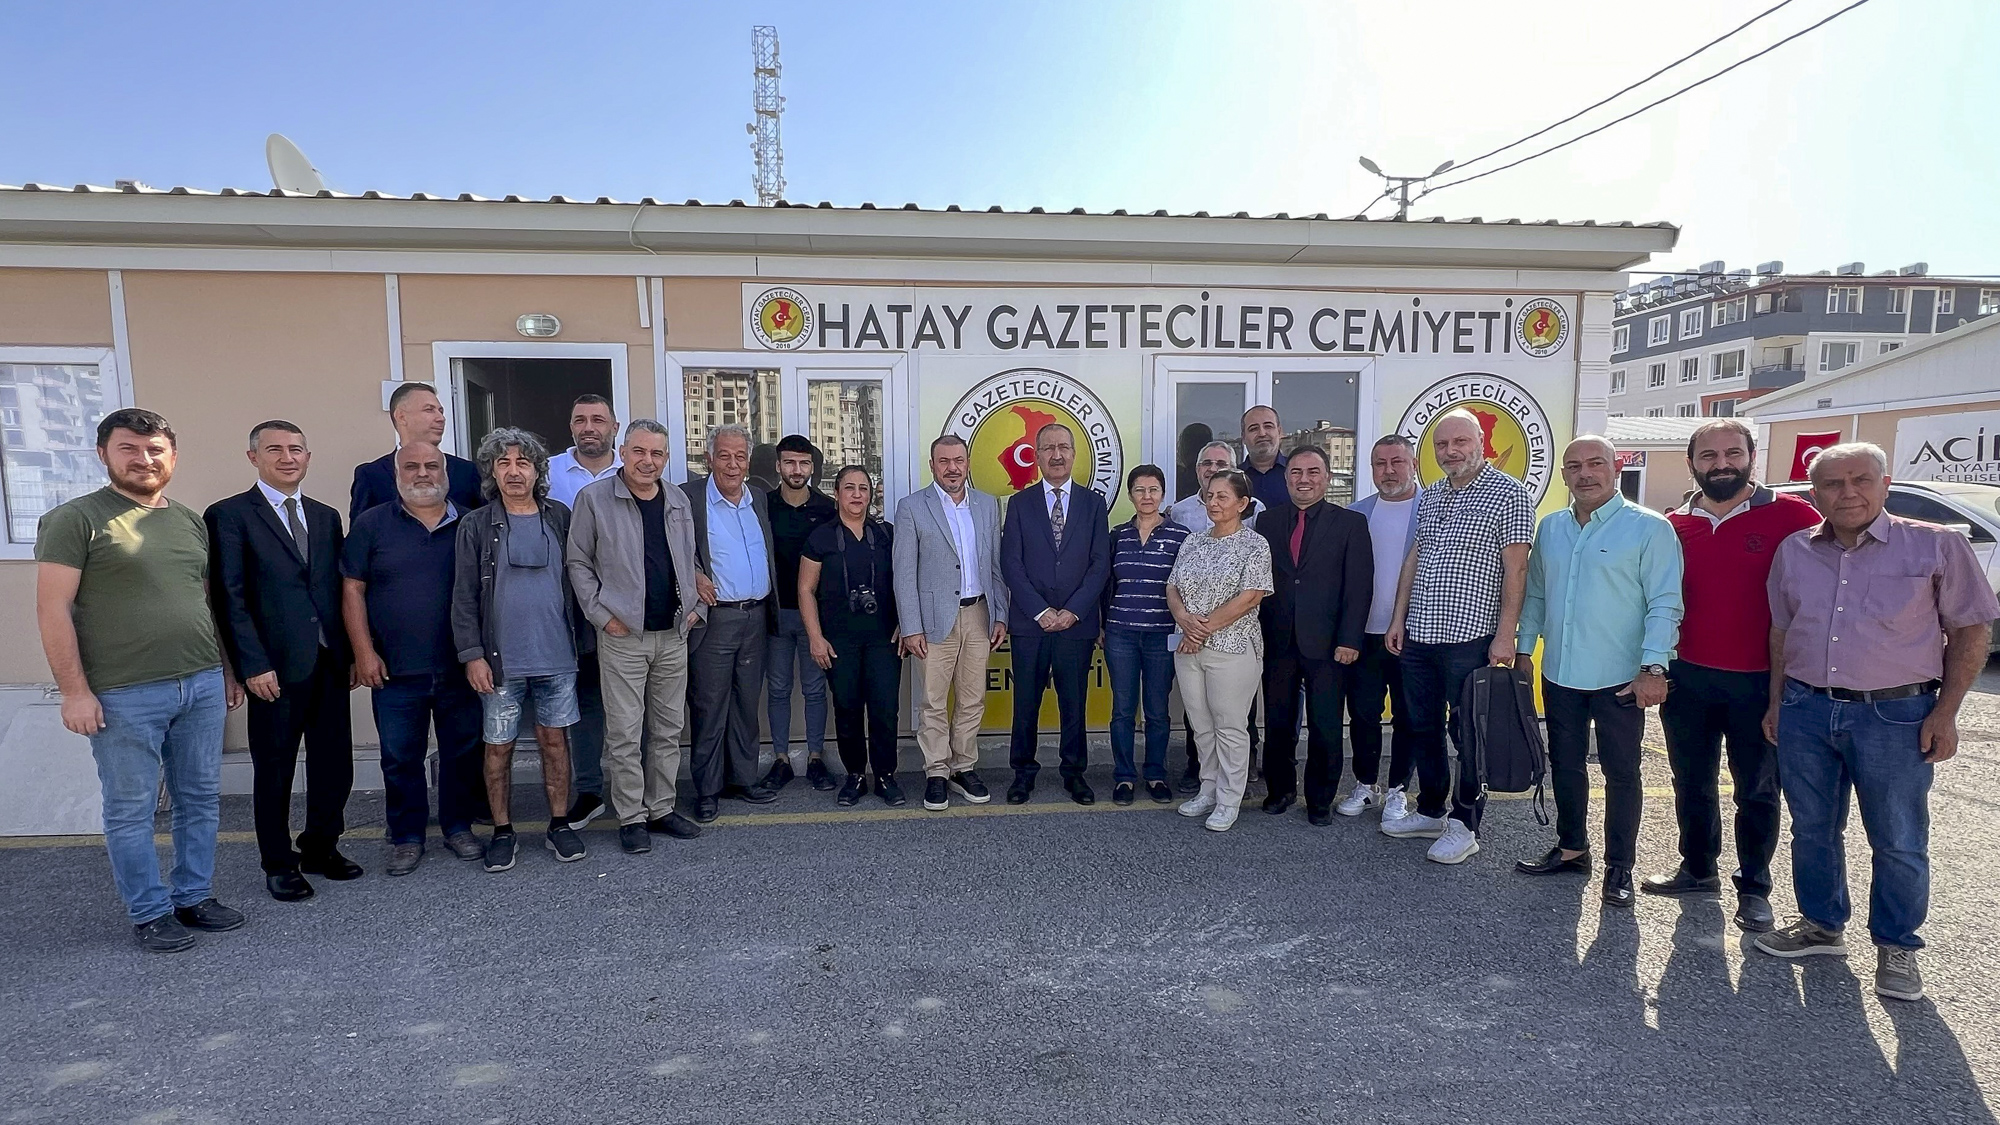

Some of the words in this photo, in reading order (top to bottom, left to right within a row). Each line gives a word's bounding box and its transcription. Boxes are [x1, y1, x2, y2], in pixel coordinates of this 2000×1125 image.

[753, 307, 762, 333] HATAY
[758, 290, 804, 308] GAZETECİLER
[818, 302, 973, 350] HATAY
[986, 291, 1294, 353] GAZETECİLER
[1309, 297, 1513, 354] CEMİYETİ
[961, 379, 1094, 429] GAZETECİLER
[1089, 422, 1117, 497] CEMİYE
[1414, 383, 1531, 426] GAZETECİLER
[1525, 421, 1549, 495] CEMİYE
